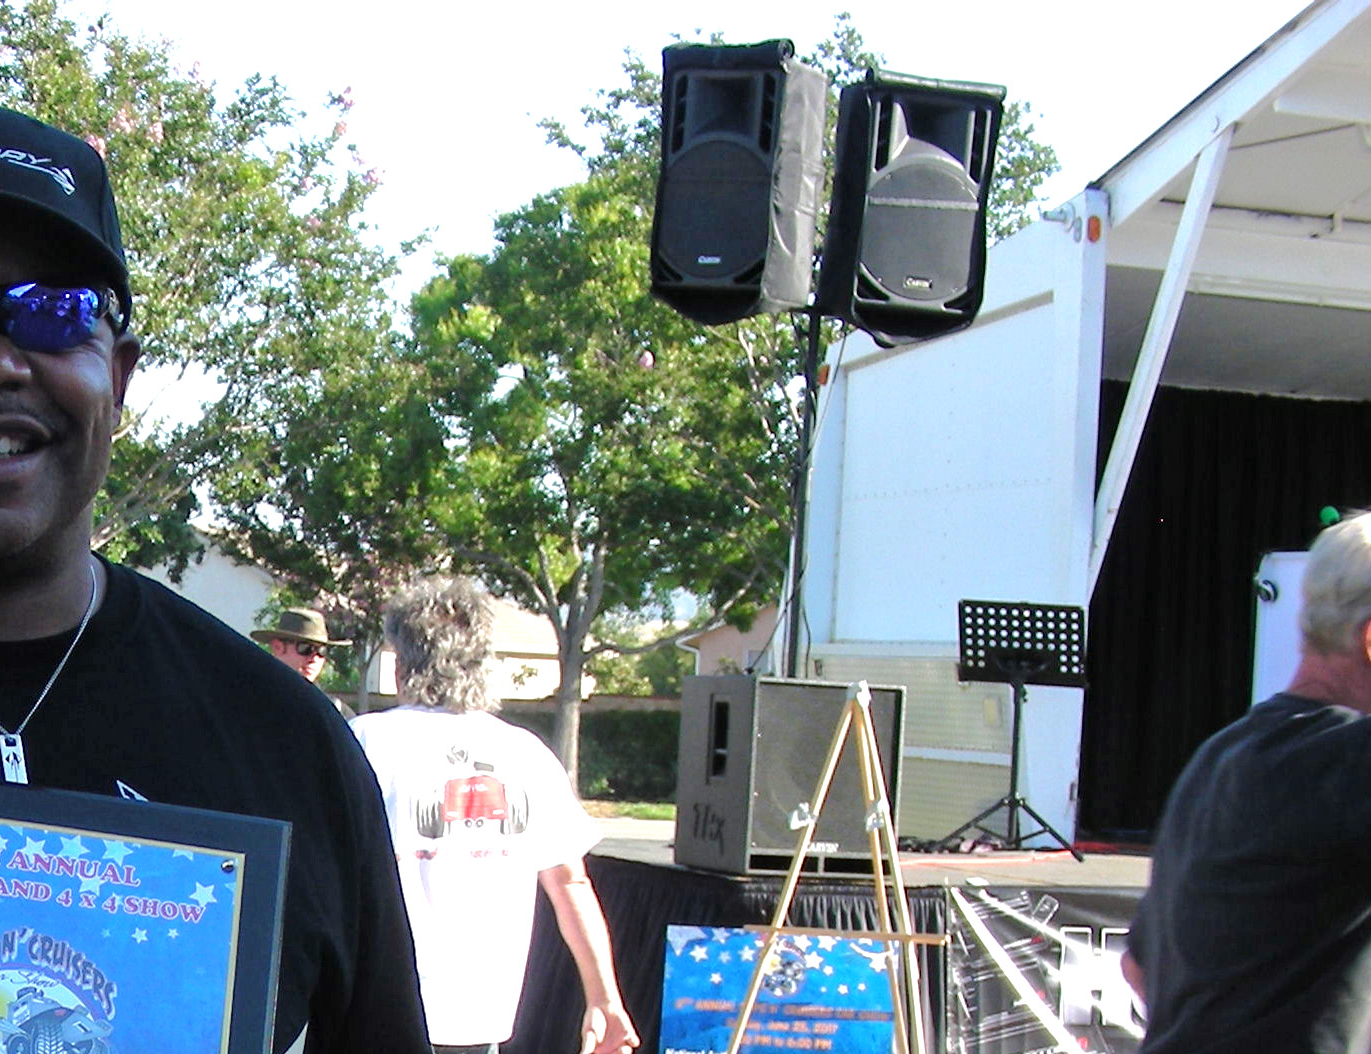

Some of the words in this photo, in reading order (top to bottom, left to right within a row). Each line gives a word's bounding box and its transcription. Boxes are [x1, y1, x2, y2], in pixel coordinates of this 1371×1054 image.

[8, 851, 141, 887] ANNUAL
[56, 889, 72, 907] 4
[102, 896, 118, 913] 4
[123, 895, 205, 923] SHOW
[28, 932, 117, 1018] CRUISERS
